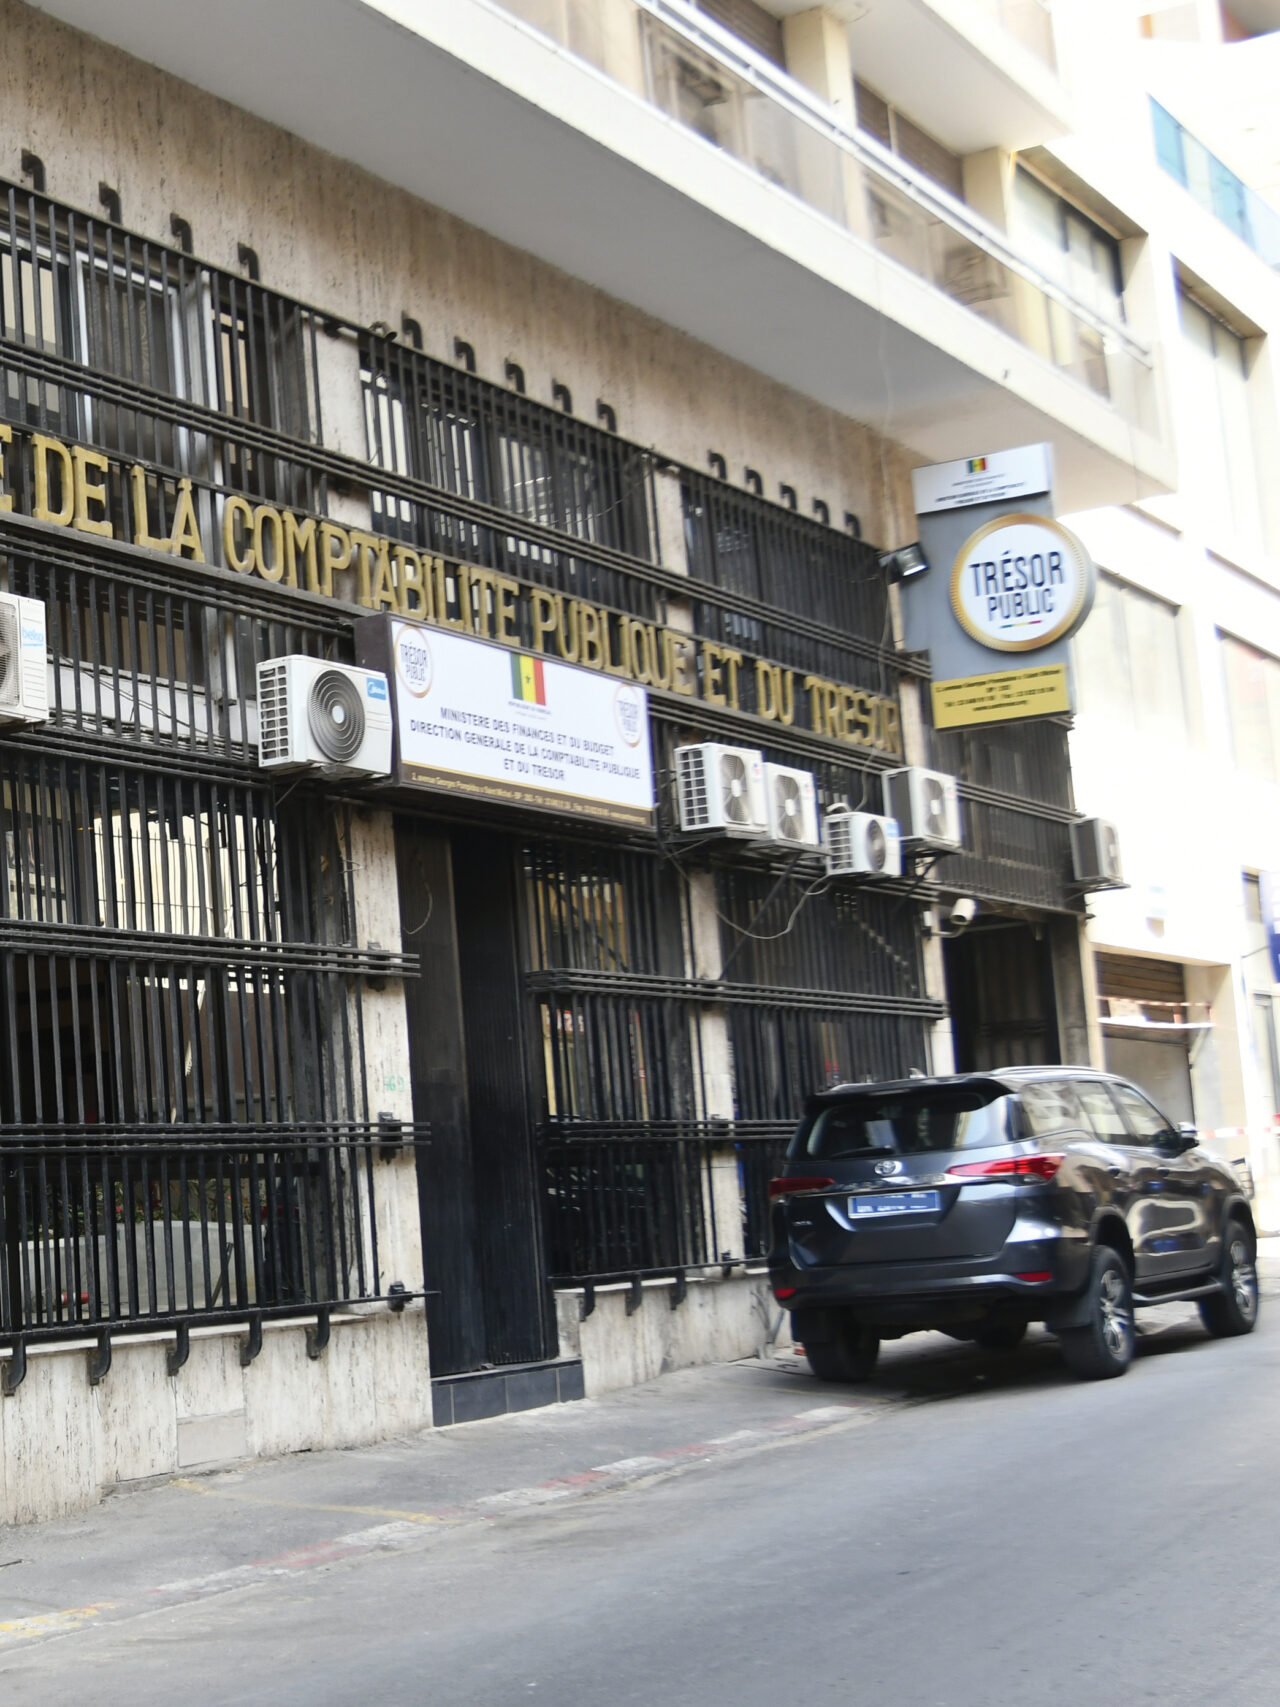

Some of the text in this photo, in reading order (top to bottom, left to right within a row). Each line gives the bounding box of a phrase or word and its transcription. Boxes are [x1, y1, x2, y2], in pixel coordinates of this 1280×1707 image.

[31, 433, 114, 538] DE
[131, 464, 206, 563] LA
[223, 495, 520, 646] COMPTABILITE
[530, 588, 693, 696] PUBLIQUE
[701, 642, 742, 710] ET
[755, 661, 794, 726] DU
[968, 549, 1065, 597] TRÉSOR
[986, 588, 1054, 621] PUBLIC
[410, 718, 641, 781] DIRECTION GENERALE DE LA COMPTABILITE PUBLIQUE
[493, 719, 510, 733] DES
[512, 723, 554, 744] FINANCES
[557, 733, 568, 746] ET
[570, 736, 581, 750] DU
[583, 739, 615, 756] BUDGET
[503, 758, 566, 781] ET DU TRESOR
